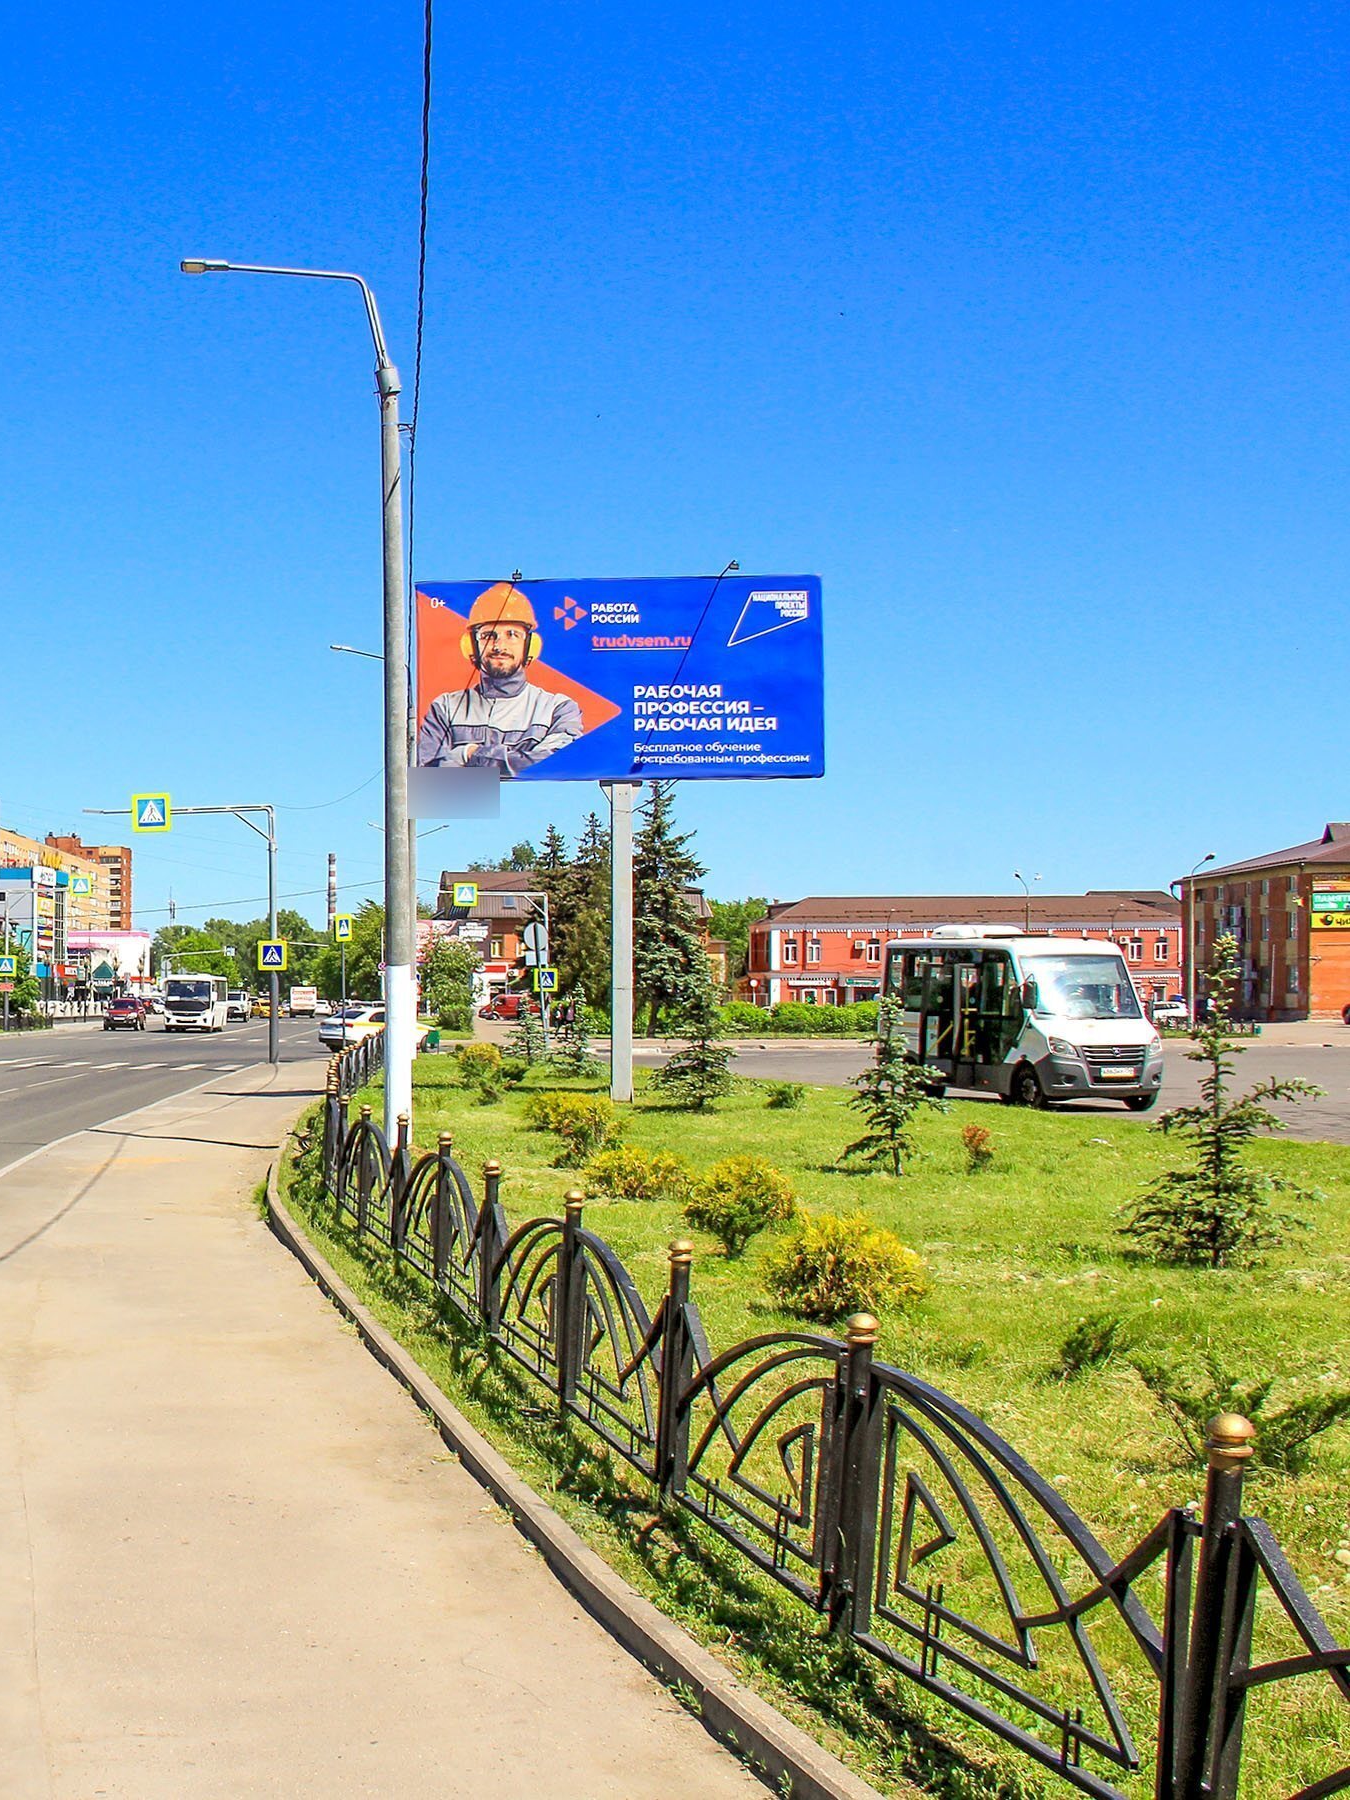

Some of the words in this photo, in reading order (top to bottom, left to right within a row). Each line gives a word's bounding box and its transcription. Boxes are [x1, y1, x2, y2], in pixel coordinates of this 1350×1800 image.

[430, 597, 446, 609] 0+
[591, 603, 637, 613] РАБОТА
[591, 614, 640, 624] РОССИИ
[591, 634, 692, 648] trudvsem.ru
[633, 684, 722, 699] РАБОЧАЯ
[633, 701, 750, 715] ПРОФЕССИЯ
[633, 717, 722, 732] РАБОЧАЯ
[726, 717, 778, 733] ИДЕЯ
[633, 743, 703, 753] Бесплатное
[704, 741, 762, 754] обучение
[633, 753, 733, 766] востребованным
[736, 753, 810, 765] профессиям
[1313, 894, 1350, 903] ПАМЯТ
